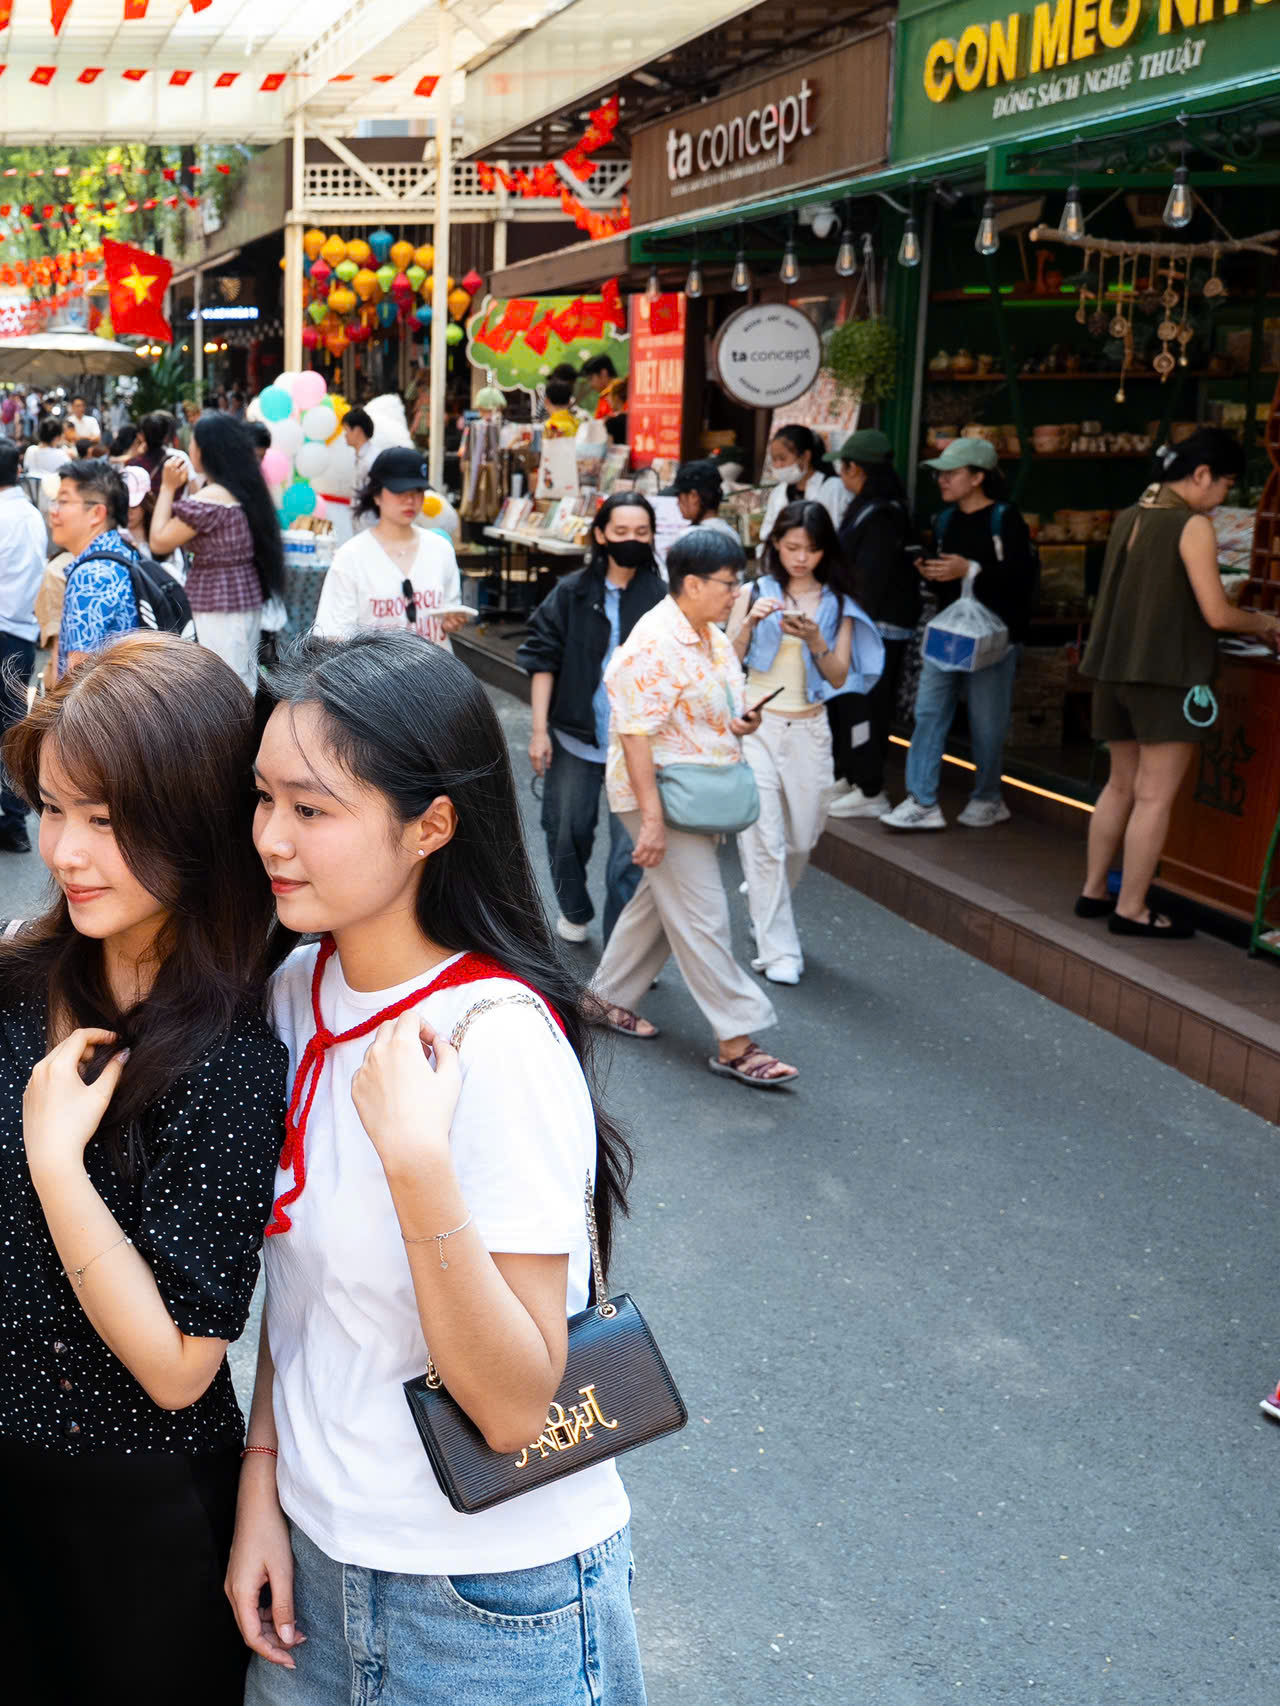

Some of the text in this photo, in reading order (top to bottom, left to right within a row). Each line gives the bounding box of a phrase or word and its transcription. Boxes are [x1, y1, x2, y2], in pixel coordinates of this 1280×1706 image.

[923, 13, 1019, 103] CON
[1037, 74, 1080, 107] SÁCH
[1083, 54, 1134, 95] NGHỆ
[1138, 37, 1206, 80] THUẬT
[666, 128, 692, 180] ta
[697, 79, 812, 165] concept
[731, 347, 811, 364] ta concept
